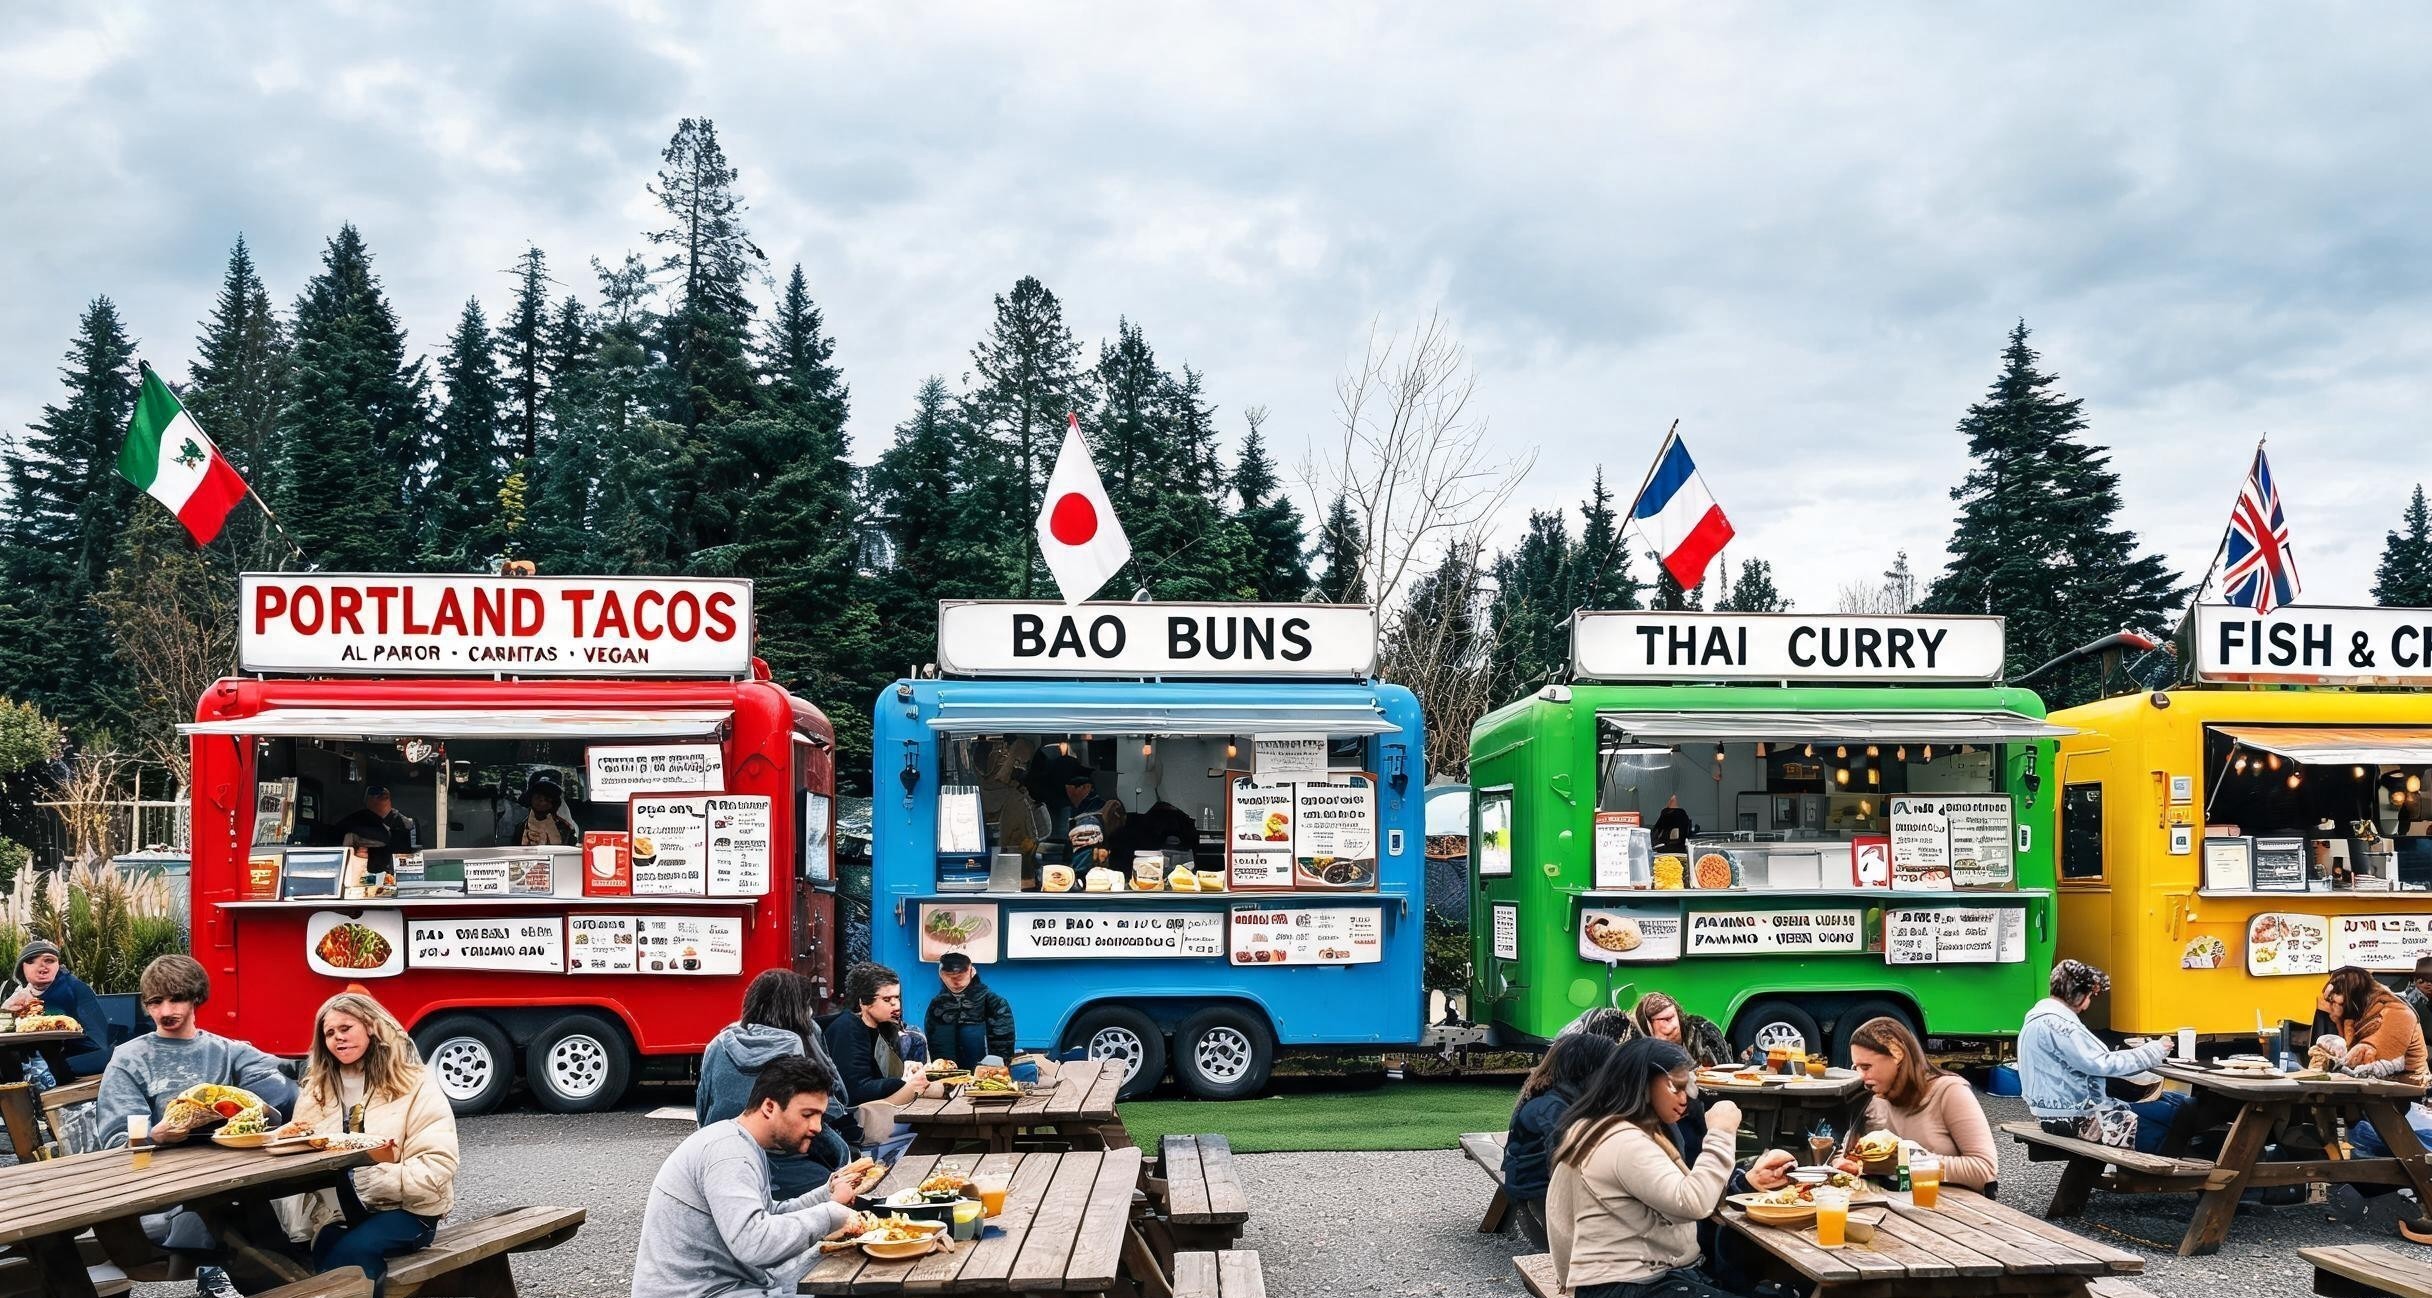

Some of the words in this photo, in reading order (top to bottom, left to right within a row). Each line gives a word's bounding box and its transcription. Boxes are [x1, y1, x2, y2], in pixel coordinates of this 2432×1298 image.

[255, 585, 545, 637] PORTLAND
[561, 589, 737, 643] TACOS
[1012, 613, 1127, 659] BAO
[1167, 615, 1313, 662] BUNS
[341, 644, 368, 661] AL
[584, 647, 649, 664] VEGAN
[1636, 624, 1747, 667] THAI
[1787, 625, 1948, 669] CURRY
[2220, 620, 2332, 667] FISH
[2348, 630, 2376, 668] &
